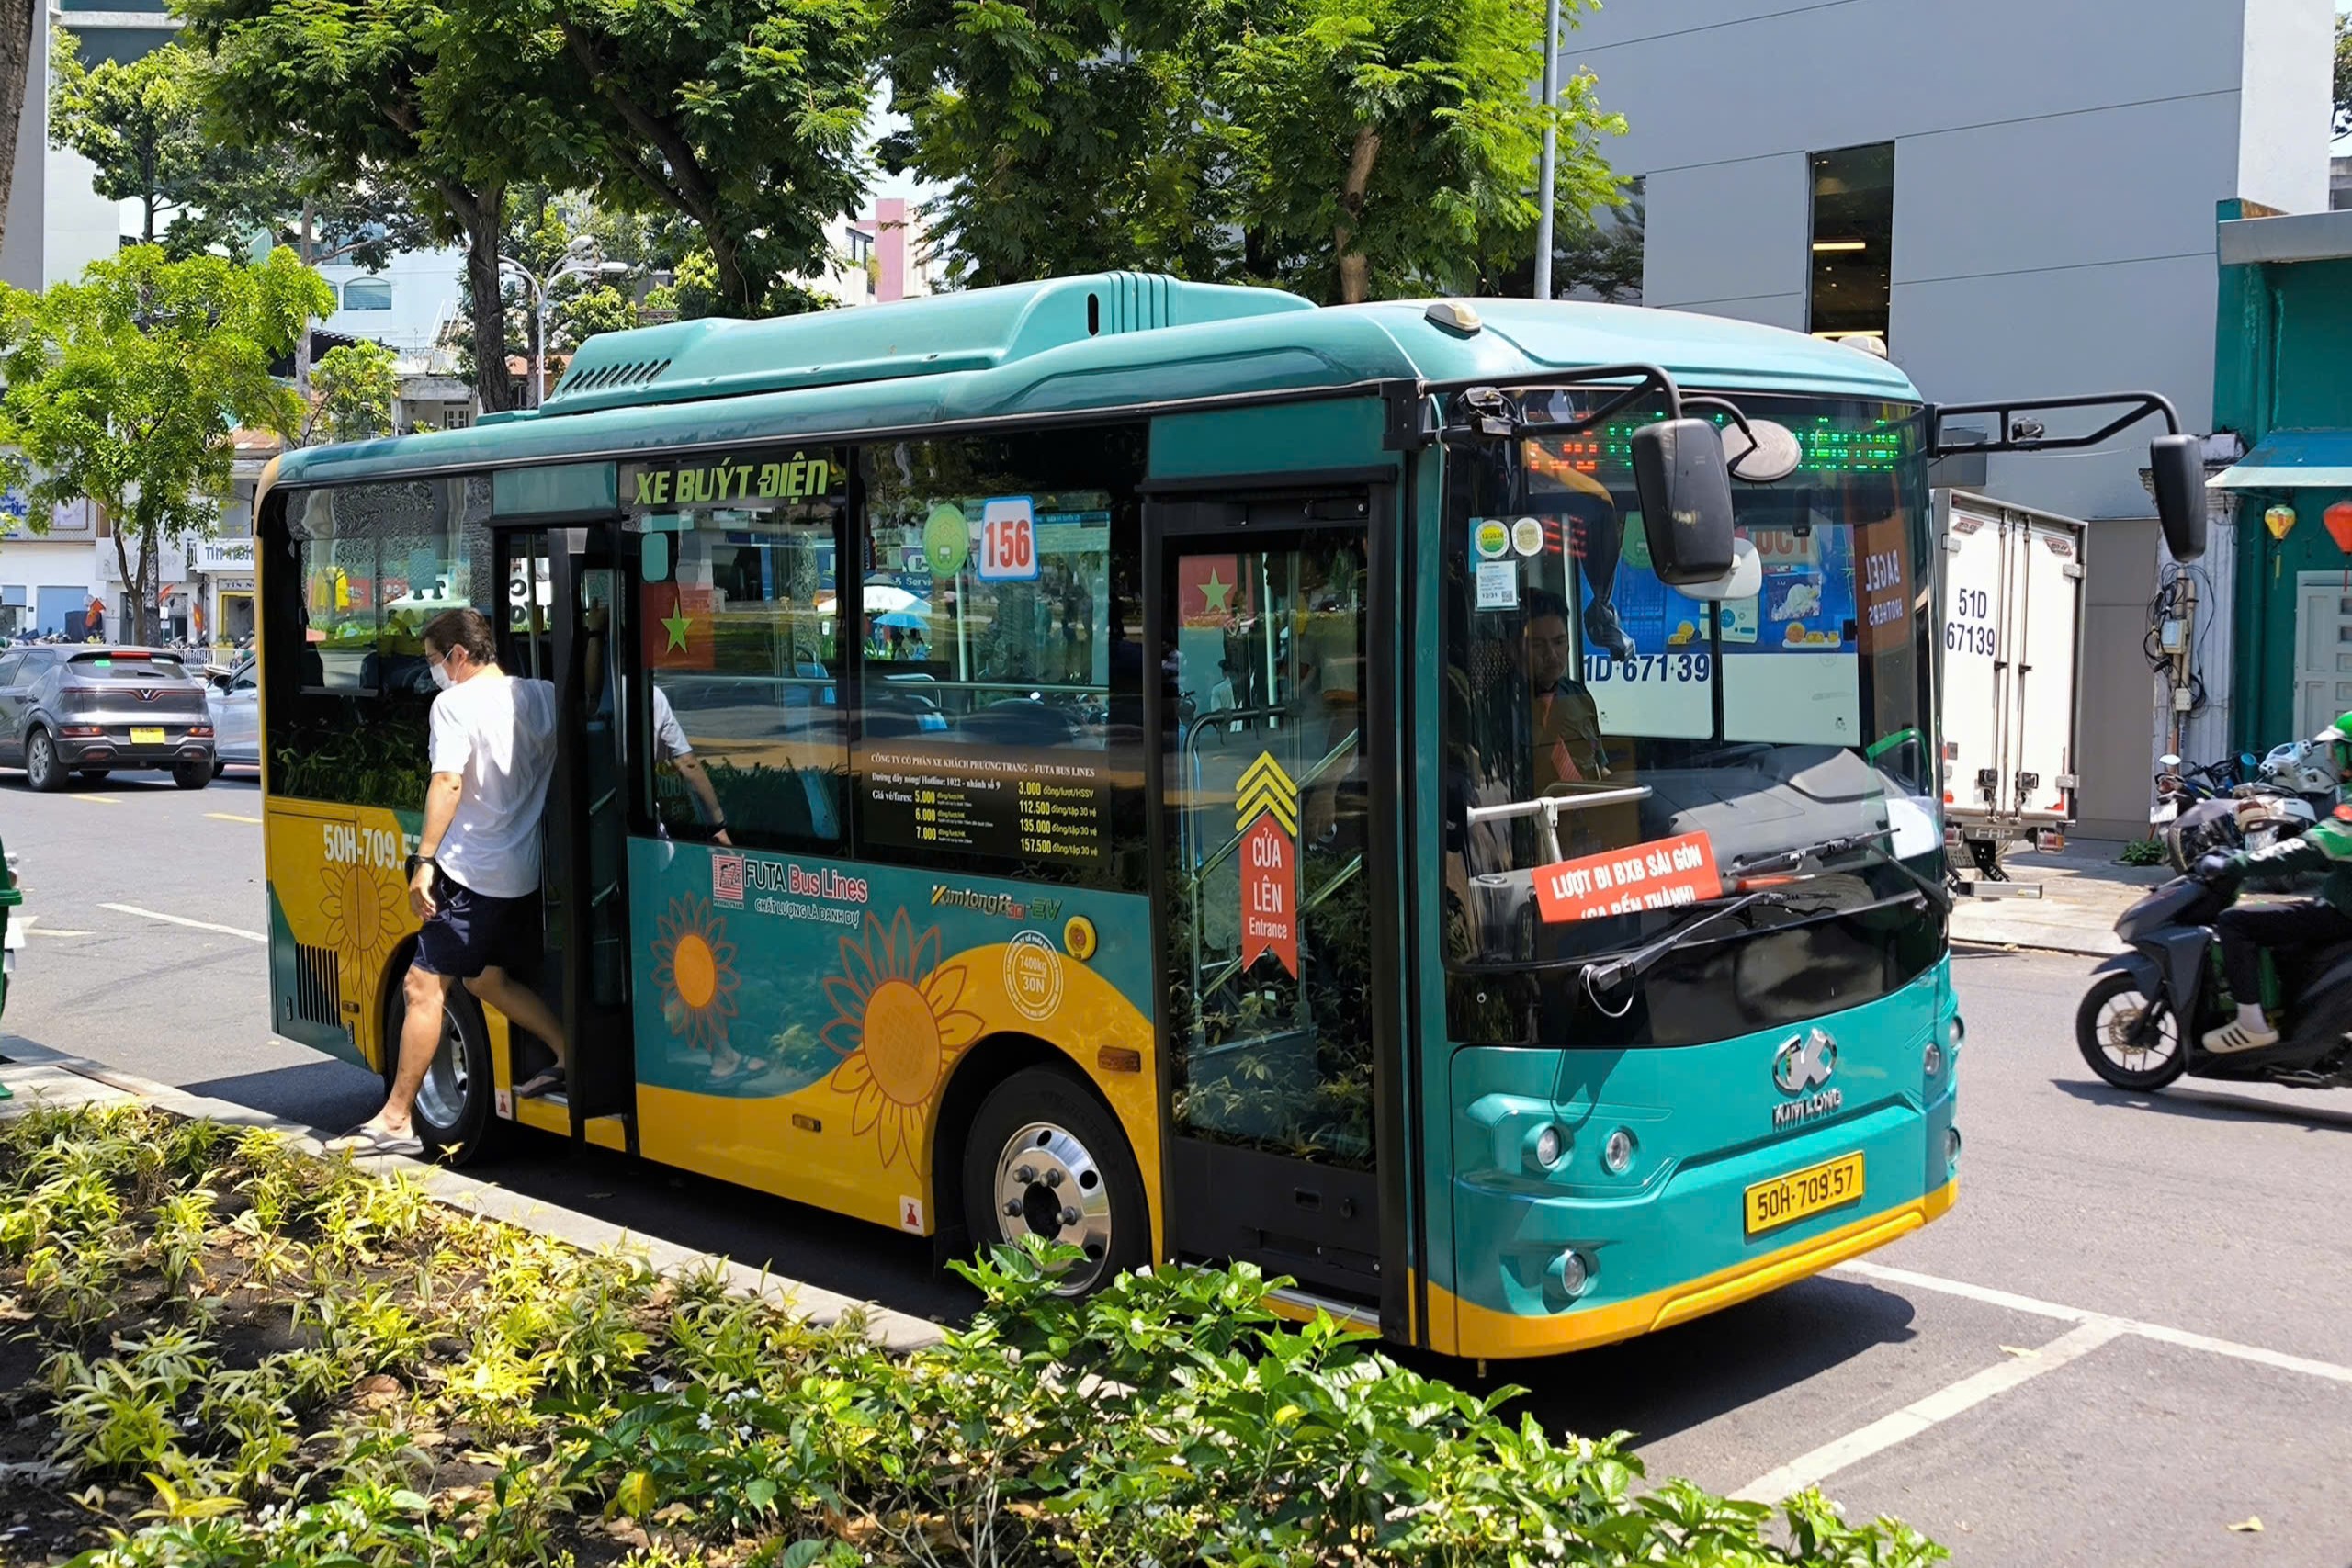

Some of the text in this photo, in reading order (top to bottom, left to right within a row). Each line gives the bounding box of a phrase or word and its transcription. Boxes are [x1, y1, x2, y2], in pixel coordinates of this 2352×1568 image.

[633, 451, 829, 505] XE BUÝT ĐIỆN
[984, 519, 1031, 569] 156
[906, 577, 933, 586] Servi
[1958, 588, 1987, 619] 51D
[1946, 621, 1996, 657] 67139
[871, 752, 891, 763] CÔNG
[891, 755, 900, 763] TY
[933, 758, 942, 767] XE
[944, 757, 969, 769] KHÁCH
[970, 760, 1001, 771] PHƯƠNG
[1001, 762, 1028, 772] TRANG
[1035, 764, 1057, 774] FUTA
[1057, 766, 1070, 776] BUS
[1071, 767, 1095, 777] LINES
[914, 790, 935, 804] 5.000
[1018, 781, 1042, 795] 3.000
[915, 807, 936, 822] 6.000
[1019, 799, 1050, 816] 112.500
[1080, 807, 1089, 816] 30
[916, 826, 936, 840] 7.000
[1020, 818, 1051, 834] 135.000
[1080, 827, 1090, 835] 30
[1021, 838, 1052, 854] 157.500
[1081, 846, 1091, 854] 30
[1252, 827, 1282, 869] CỬA
[744, 860, 868, 903] FUTA Bus Lines
[1550, 841, 1703, 899] LƯỢT ĐI BXB SÀI GÒN
[1253, 874, 1282, 914] LÊN
[754, 897, 777, 913] CHẤT
[777, 901, 806, 919] LƯỢNG
[807, 903, 819, 920] LÀ
[820, 908, 843, 924] DANH
[1250, 917, 1287, 940] Entrance
[1019, 954, 1047, 975] 7400kg
[1023, 977, 1045, 994] 30N
[1773, 1089, 1842, 1128] KIM LONG
[1758, 1165, 1854, 1221] 50H-709.57
